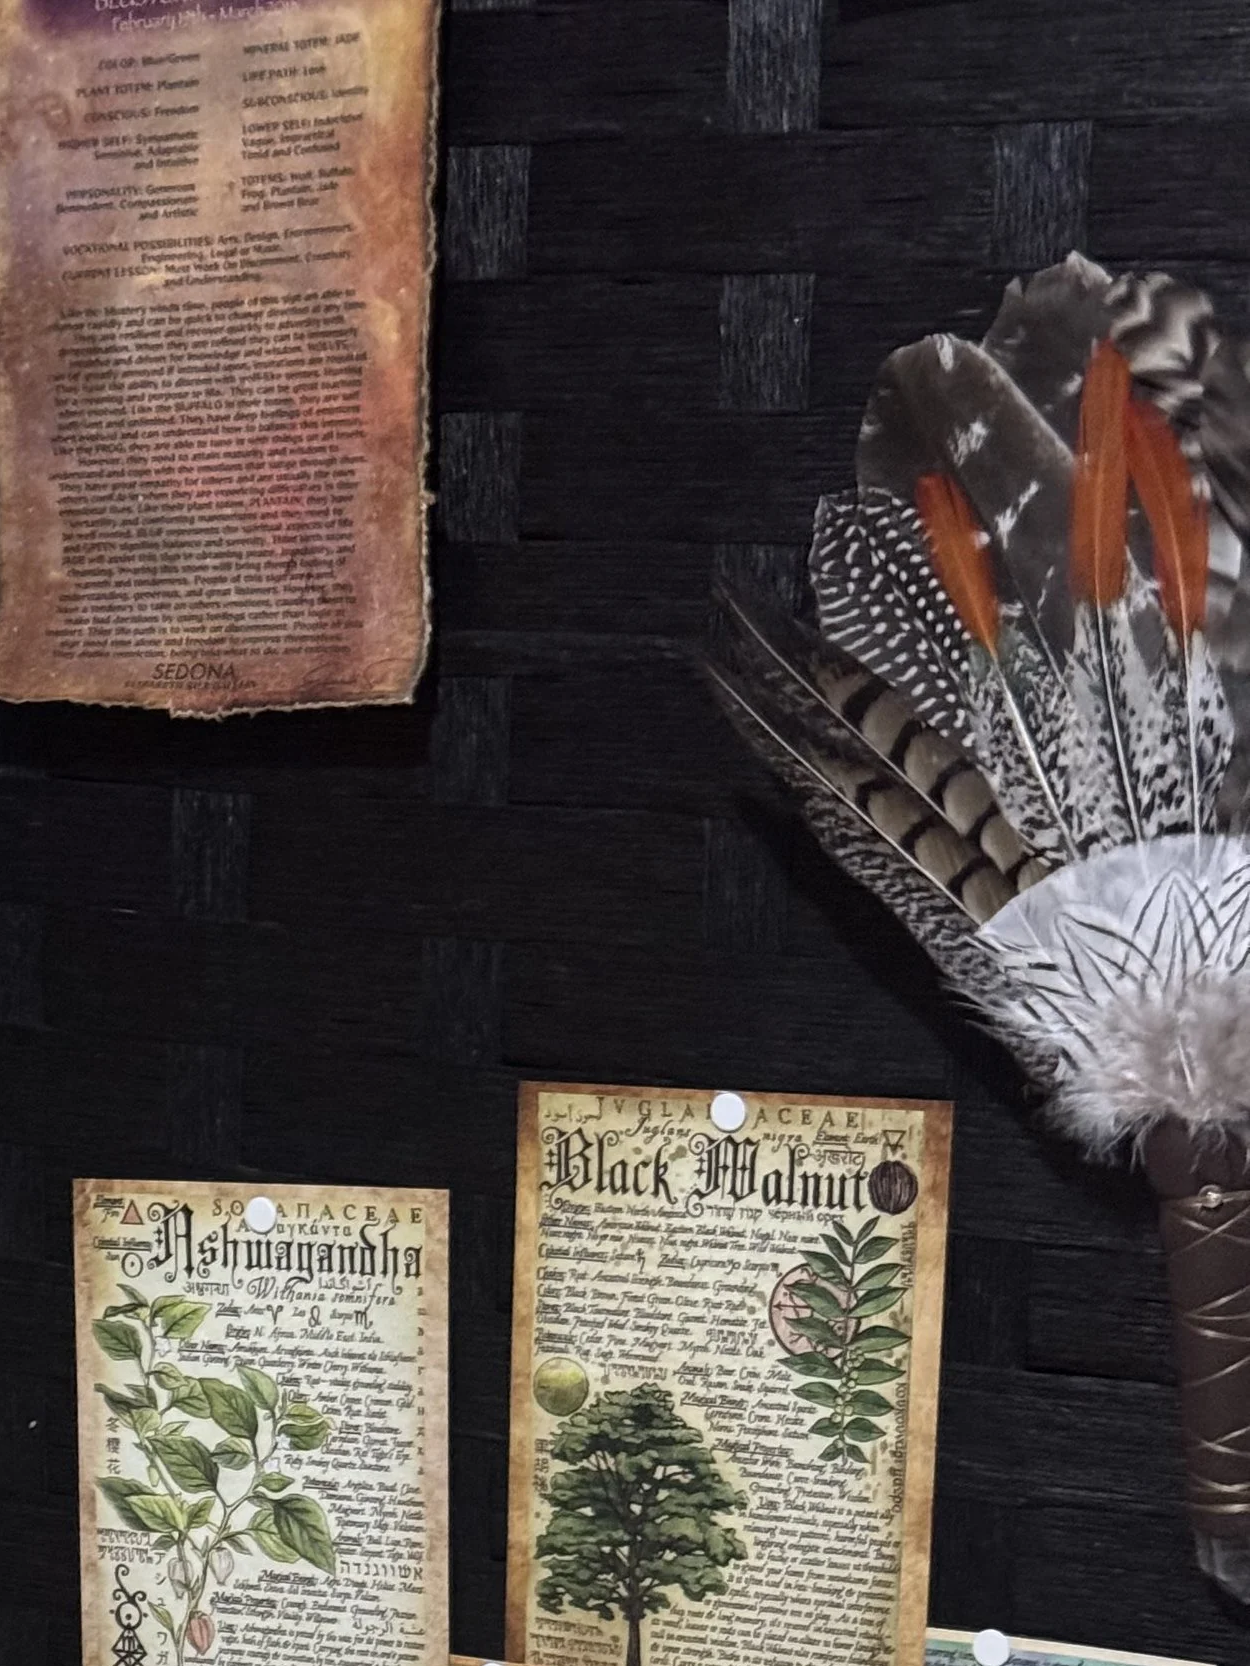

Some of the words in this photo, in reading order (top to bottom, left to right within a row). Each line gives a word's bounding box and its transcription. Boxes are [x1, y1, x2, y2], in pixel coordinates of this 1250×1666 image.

[151, 662, 237, 680] SEDONA
[539, 1126, 679, 1206] Black
[686, 1133, 868, 1217] Walnut
[147, 1201, 423, 1294] Ashwagandha
[247, 1276, 325, 1303] Withania
